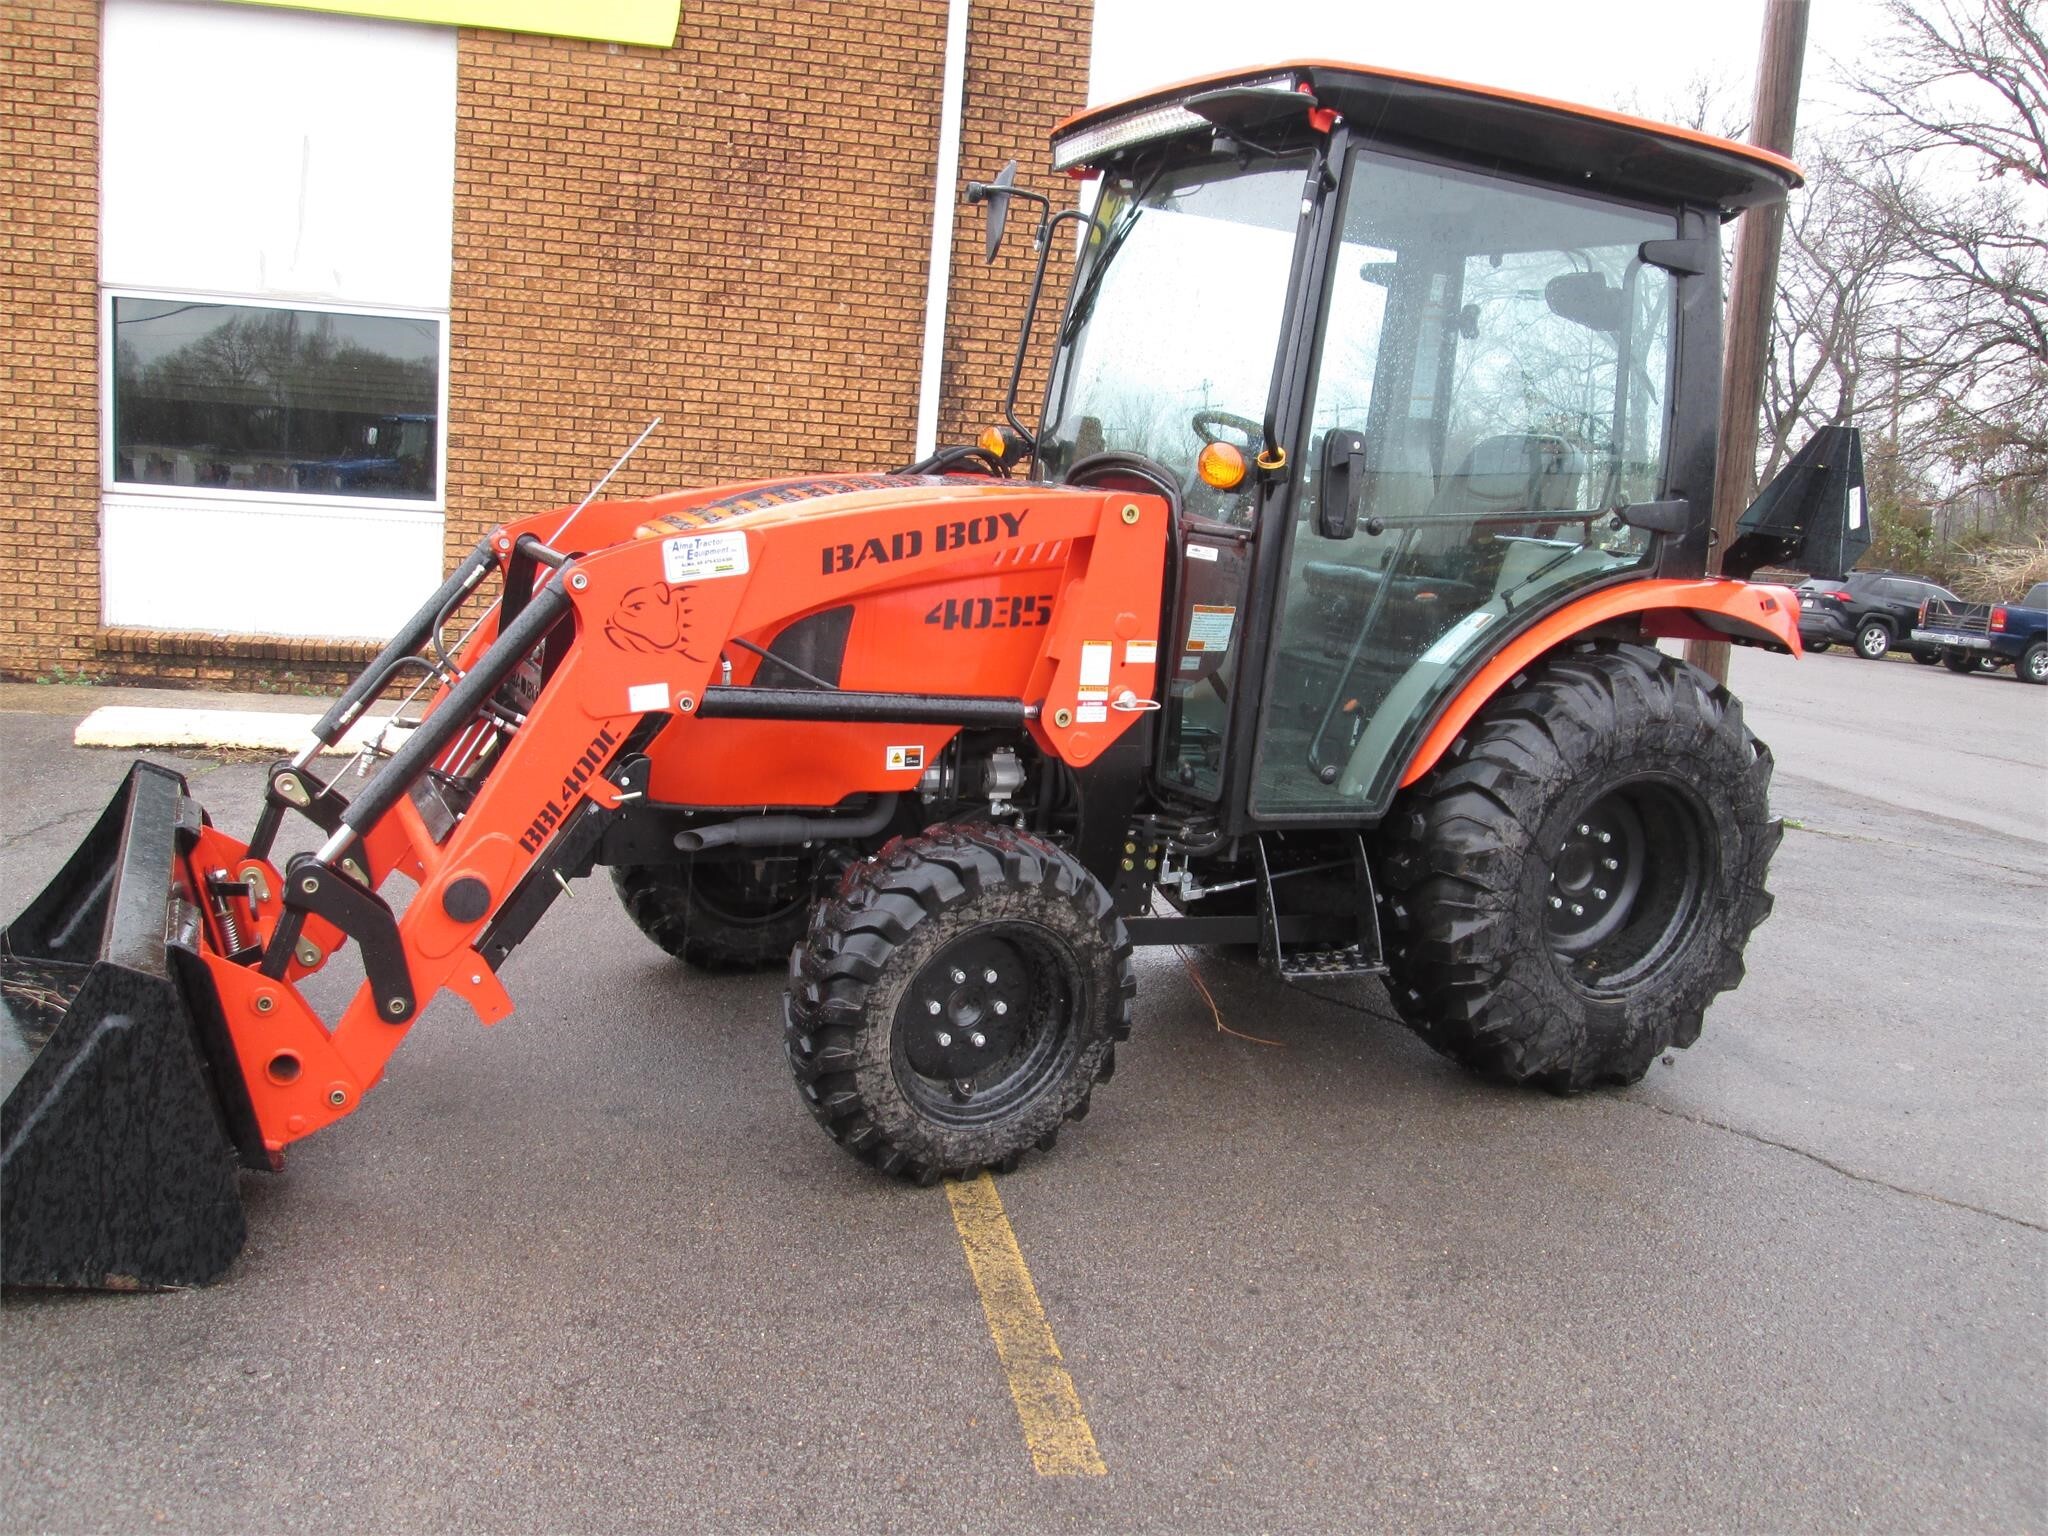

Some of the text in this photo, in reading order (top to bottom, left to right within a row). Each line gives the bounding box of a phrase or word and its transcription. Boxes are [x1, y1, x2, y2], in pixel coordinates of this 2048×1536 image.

[687, 547, 729, 561] Equipment
[694, 538, 724, 549] Tractor
[822, 508, 1030, 575] BAD BOY
[924, 595, 1054, 631] 4035
